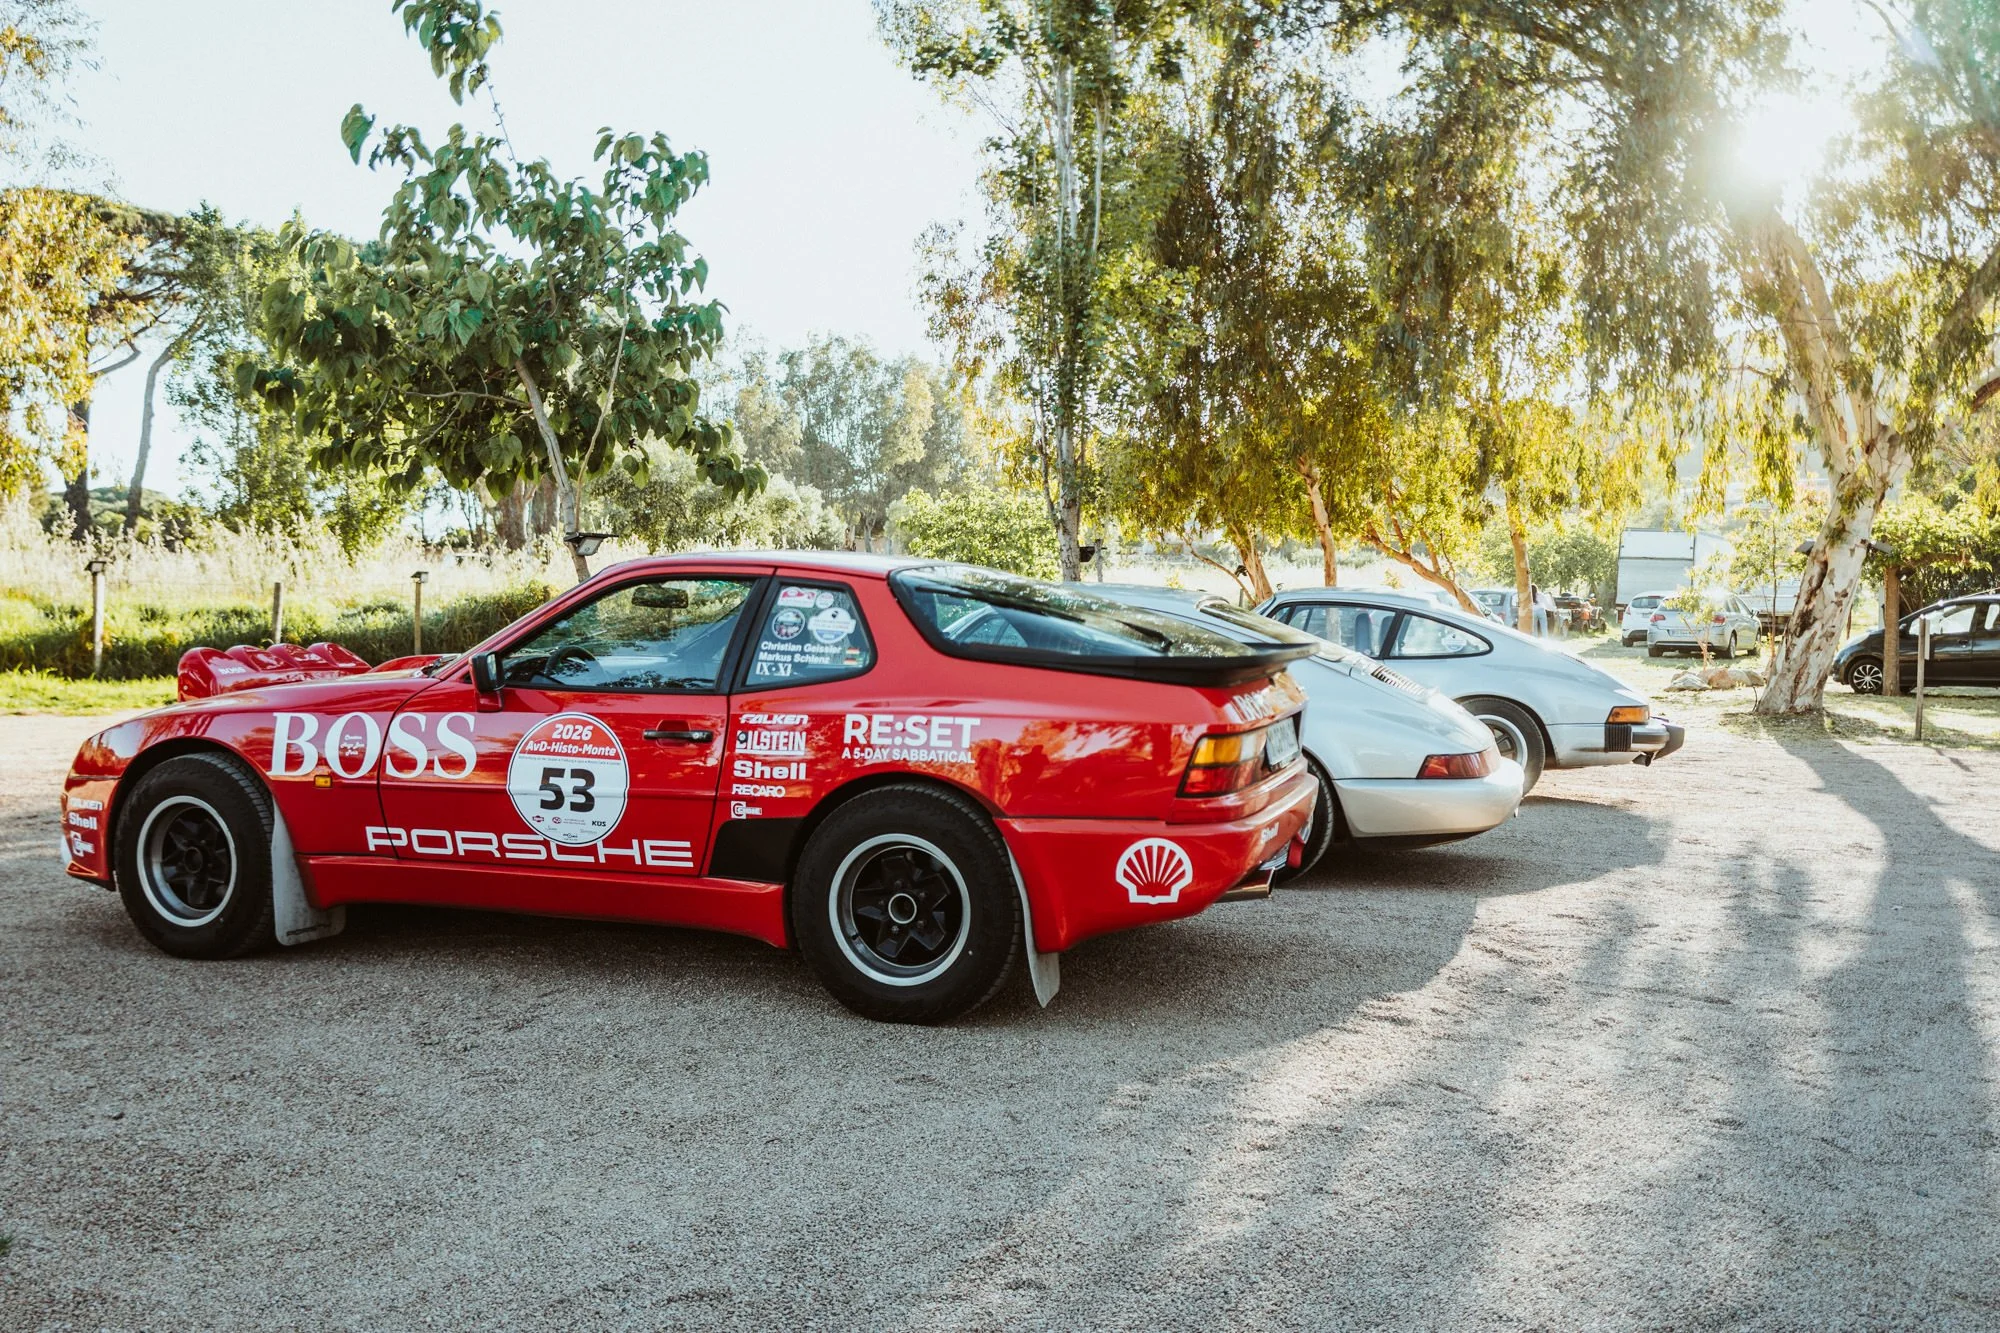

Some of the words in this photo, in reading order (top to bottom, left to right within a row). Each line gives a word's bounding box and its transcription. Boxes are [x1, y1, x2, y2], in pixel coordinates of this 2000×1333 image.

[761, 641, 802, 652] Christian
[759, 652, 792, 662] Markus
[739, 714, 809, 725] FALKEN
[552, 724, 593, 741] 2026
[843, 714, 981, 749] RE:SET
[267, 712, 477, 779] BOSS
[525, 741, 616, 757] AvD-Histo-Monte
[841, 747, 852, 760] A
[853, 748, 890, 761] 5-DAY
[892, 749, 976, 764] SABBATICAL
[733, 760, 807, 780] Shell
[539, 767, 595, 813] 53
[732, 783, 786, 798] RECARO
[69, 811, 97, 830] Shell
[365, 826, 694, 867] PORSCHE
